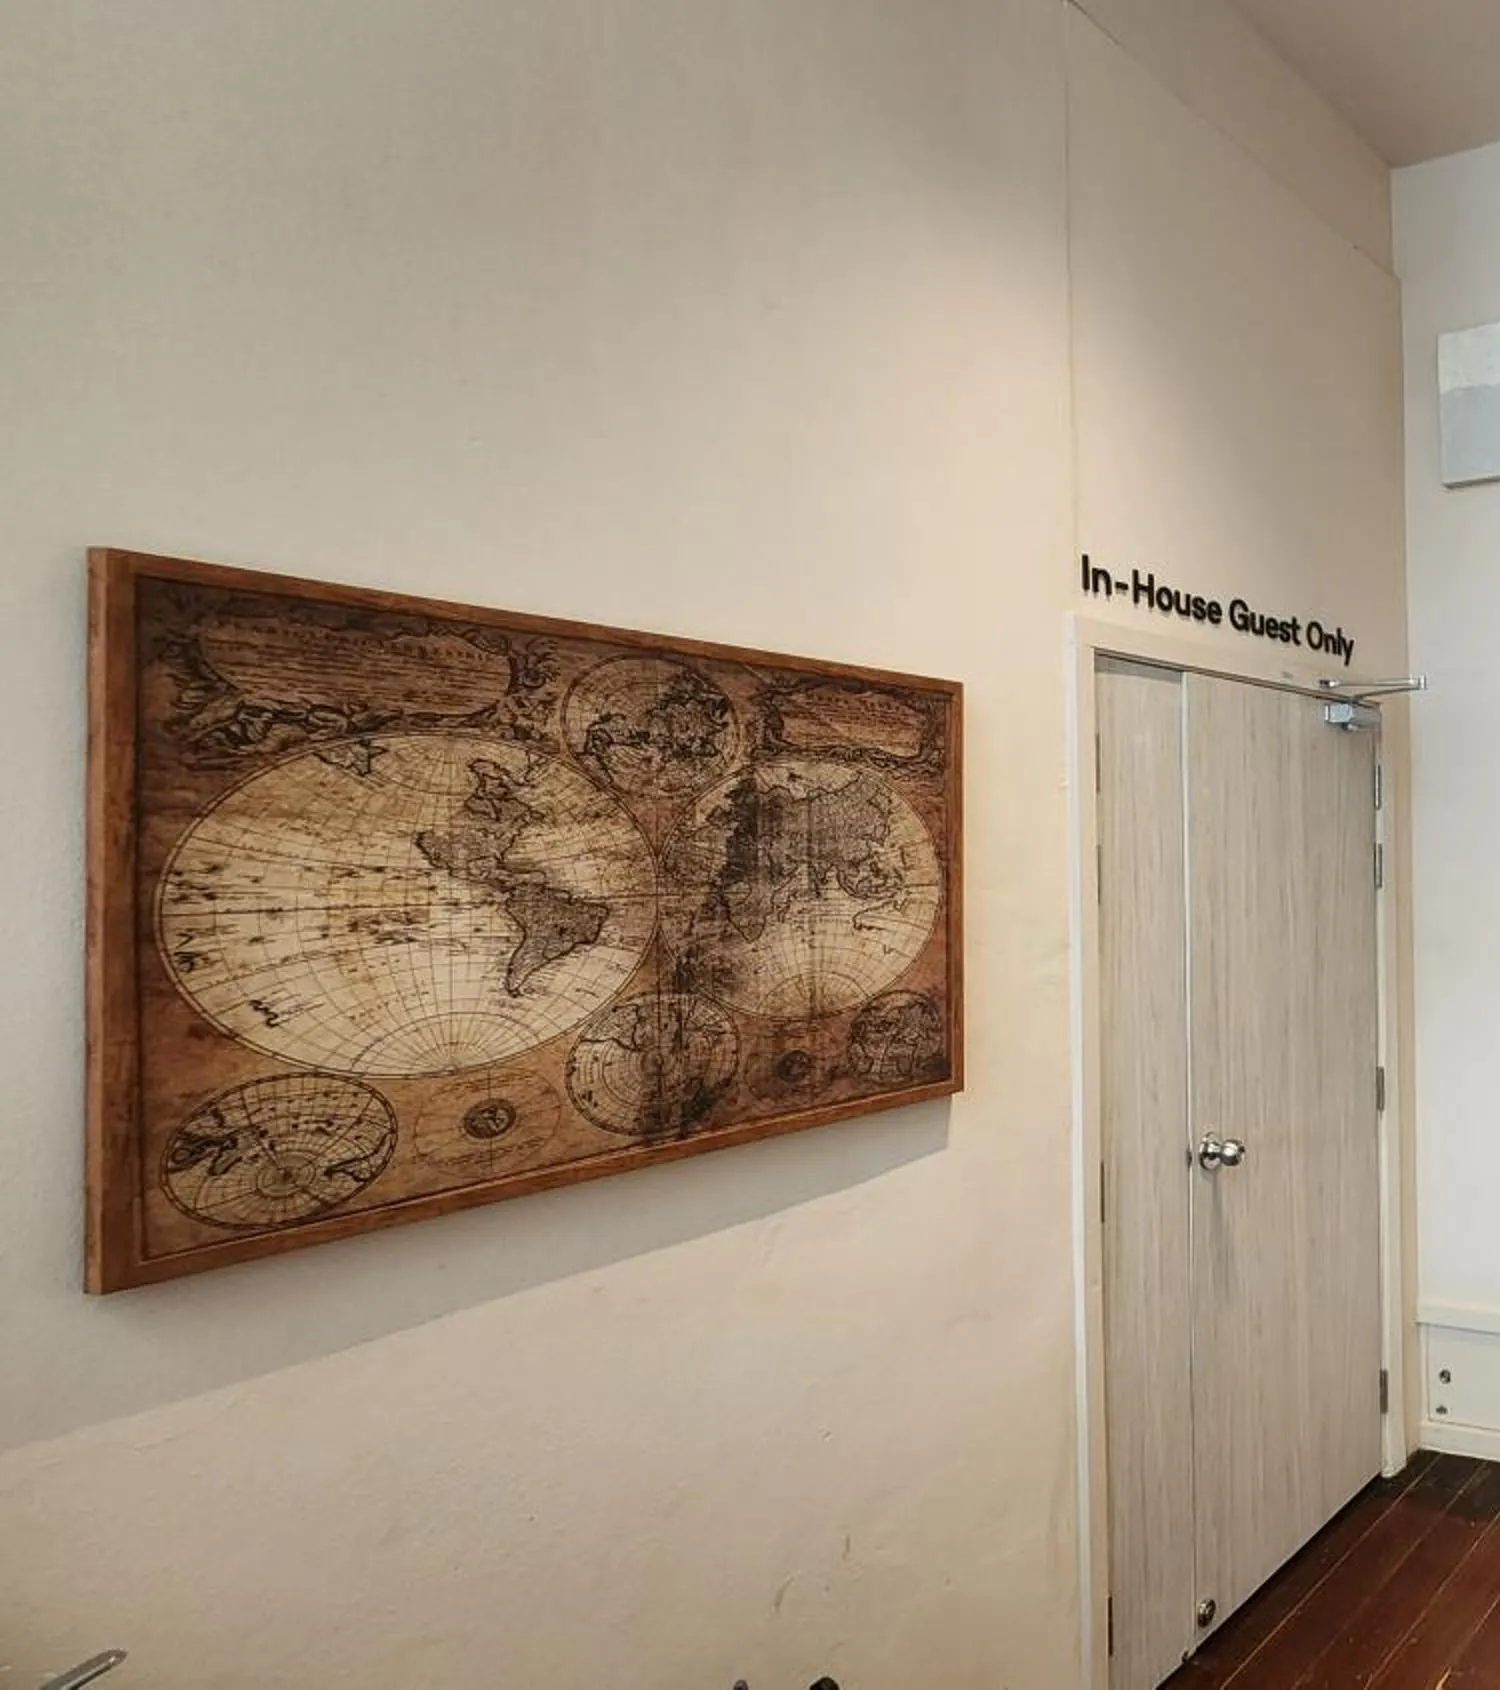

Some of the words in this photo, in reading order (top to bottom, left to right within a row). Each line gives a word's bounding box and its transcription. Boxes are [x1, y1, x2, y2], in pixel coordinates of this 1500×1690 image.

[1081, 554, 1223, 625] In-House
[1229, 598, 1302, 646] Guest
[1306, 621, 1355, 666] Only
